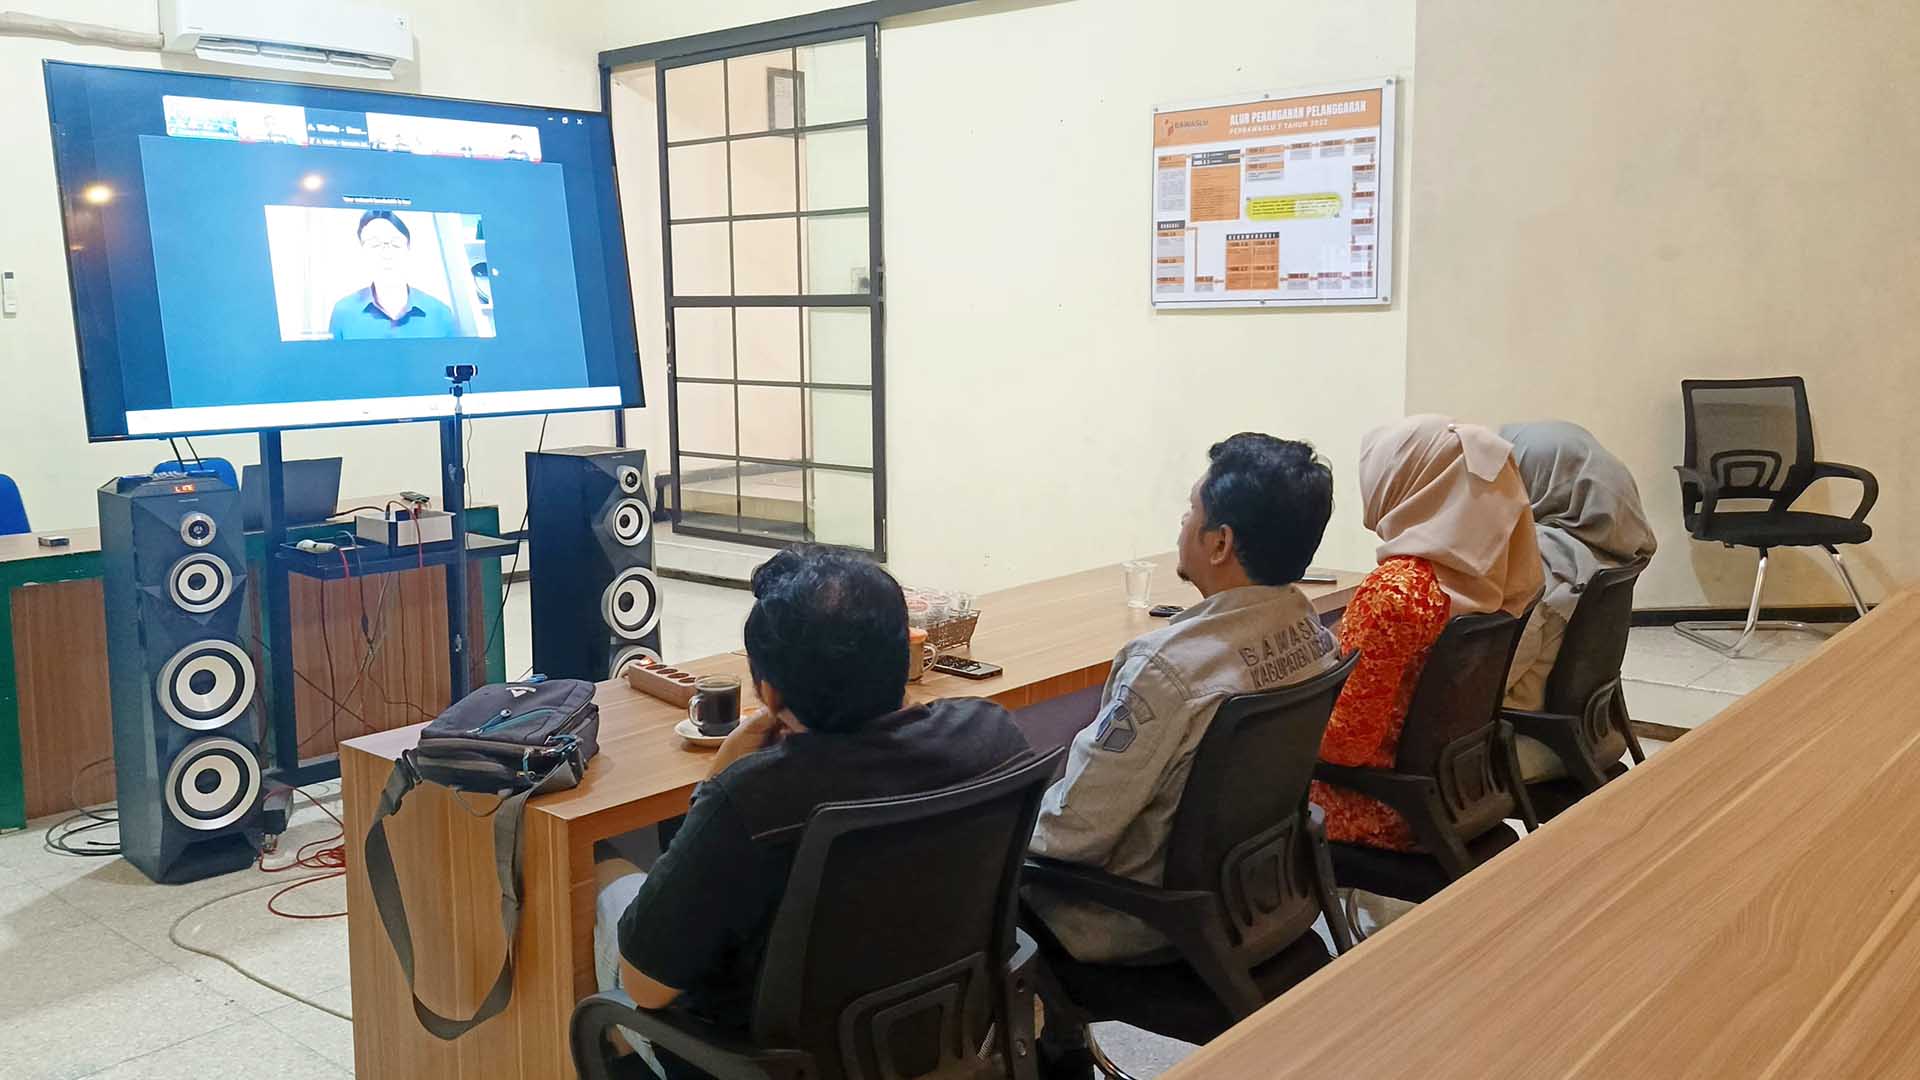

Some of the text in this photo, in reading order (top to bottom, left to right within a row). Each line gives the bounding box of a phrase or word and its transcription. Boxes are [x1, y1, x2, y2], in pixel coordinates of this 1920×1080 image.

[1230, 112, 1250, 126] ALUR
[1238, 616, 1320, 668] BAWASL
[1248, 642, 1312, 690] KABUPATEN
